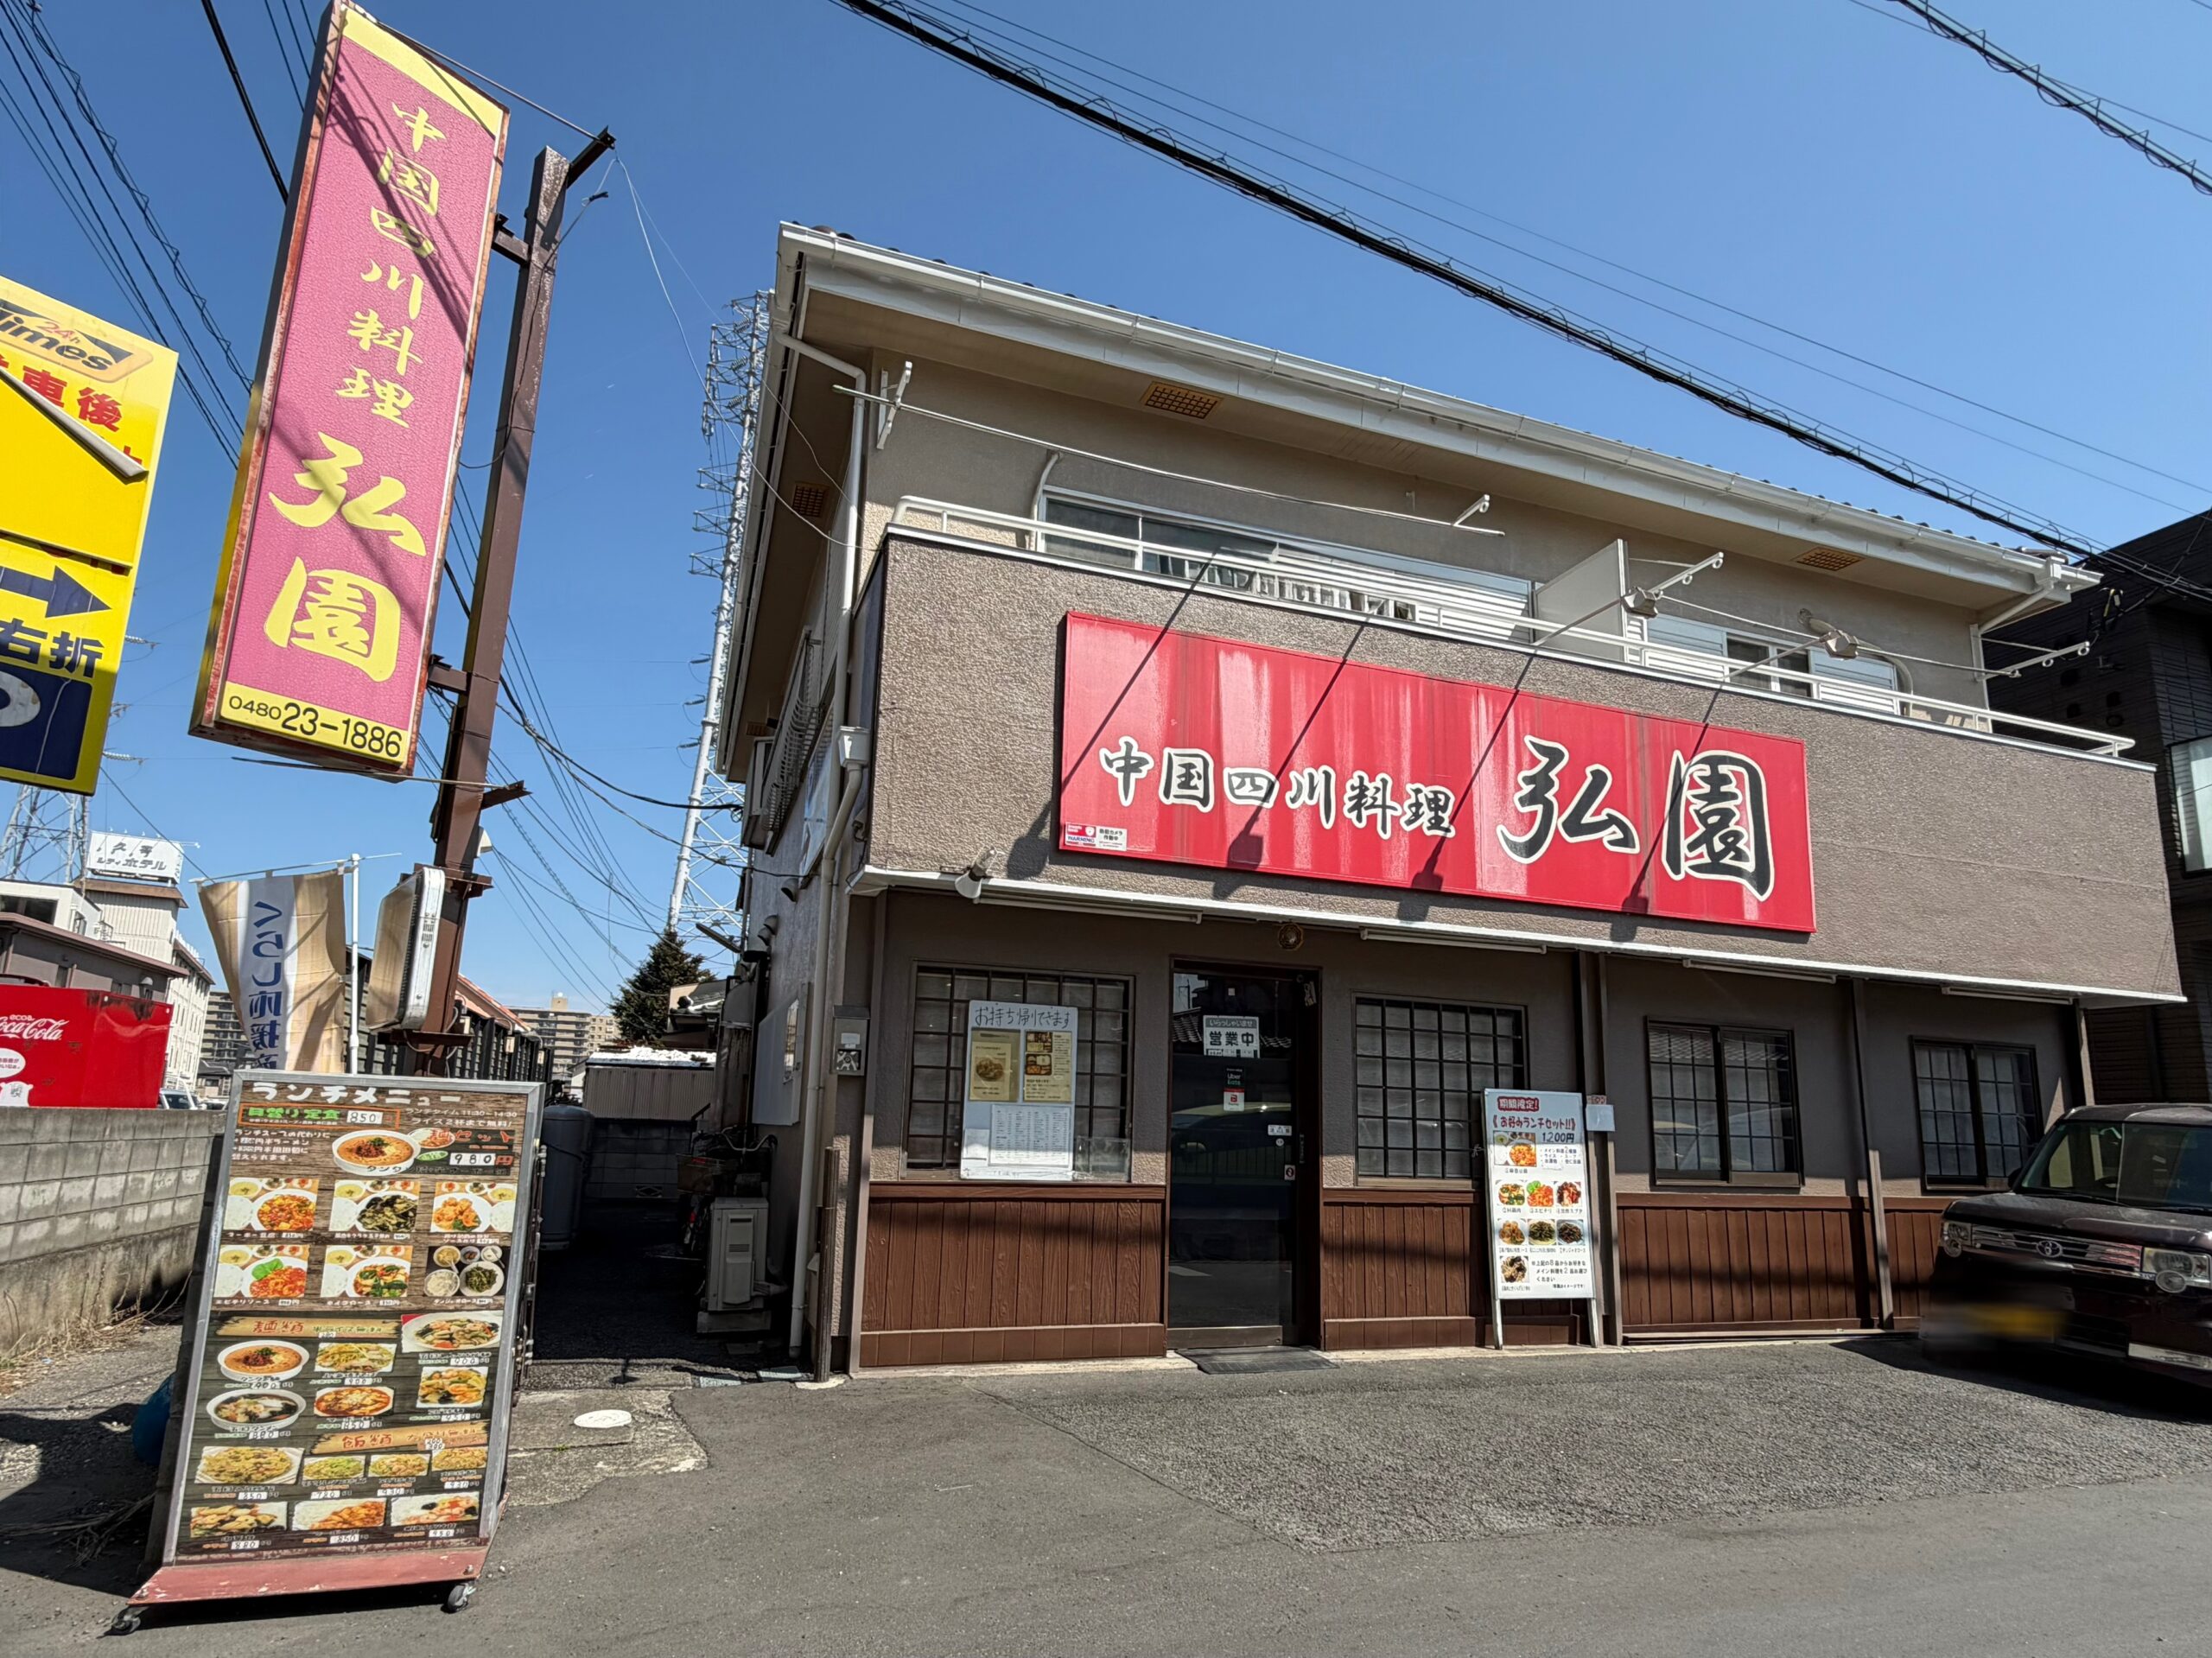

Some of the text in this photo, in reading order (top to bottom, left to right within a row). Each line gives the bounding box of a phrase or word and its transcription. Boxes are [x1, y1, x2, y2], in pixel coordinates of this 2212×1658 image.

[336, 101, 444, 429] 中国四川料理
[0, 354, 123, 433] 車後
[262, 431, 426, 683] 弘園
[229, 696, 403, 758] 0480 23-1886
[1099, 734, 1777, 901] 中国四川料理 弘園
[1209, 1031, 1255, 1047] 営業中
[251, 1082, 462, 1107] ランチメニュー
[350, 1111, 377, 1123] 850
